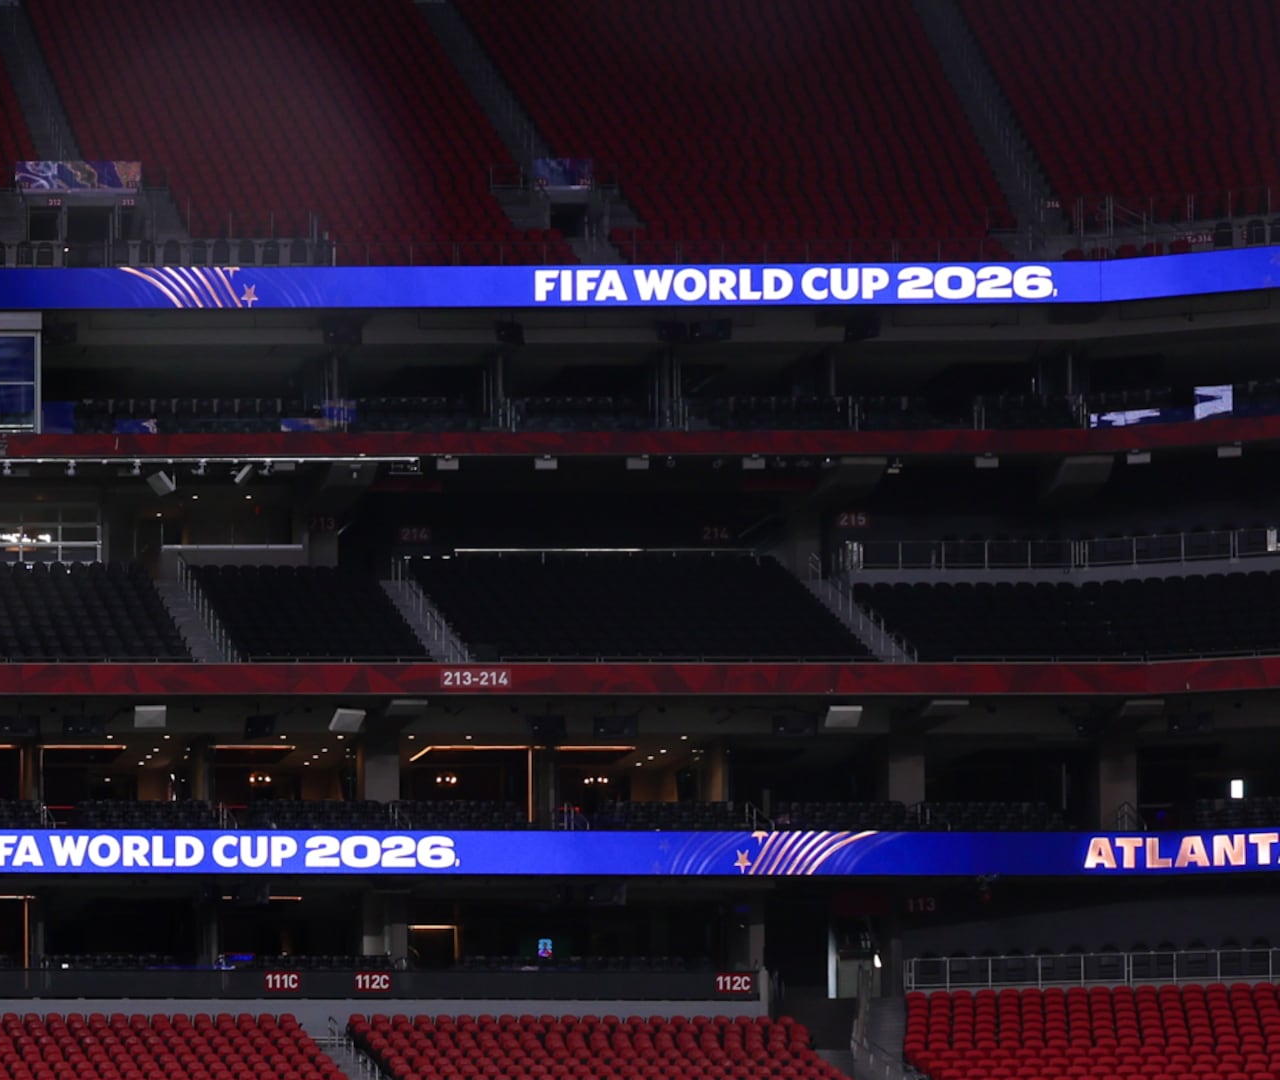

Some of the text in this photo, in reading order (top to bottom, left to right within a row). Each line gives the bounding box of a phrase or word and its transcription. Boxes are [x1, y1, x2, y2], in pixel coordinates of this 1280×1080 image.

[535, 266, 1053, 301] FIFA WORLD CUP 2026
[840, 512, 866, 526] 215
[401, 528, 428, 541] 214
[703, 526, 729, 540] 214
[443, 671, 509, 686] 213-214
[49, 835, 204, 867] WORLD
[212, 835, 297, 867] CUP
[305, 836, 454, 868] 2026
[1084, 833, 1280, 869] ATLANT
[905, 896, 937, 913] 113
[266, 974, 299, 989] 111C
[355, 974, 391, 989] 112C
[716, 975, 752, 990] 112C
